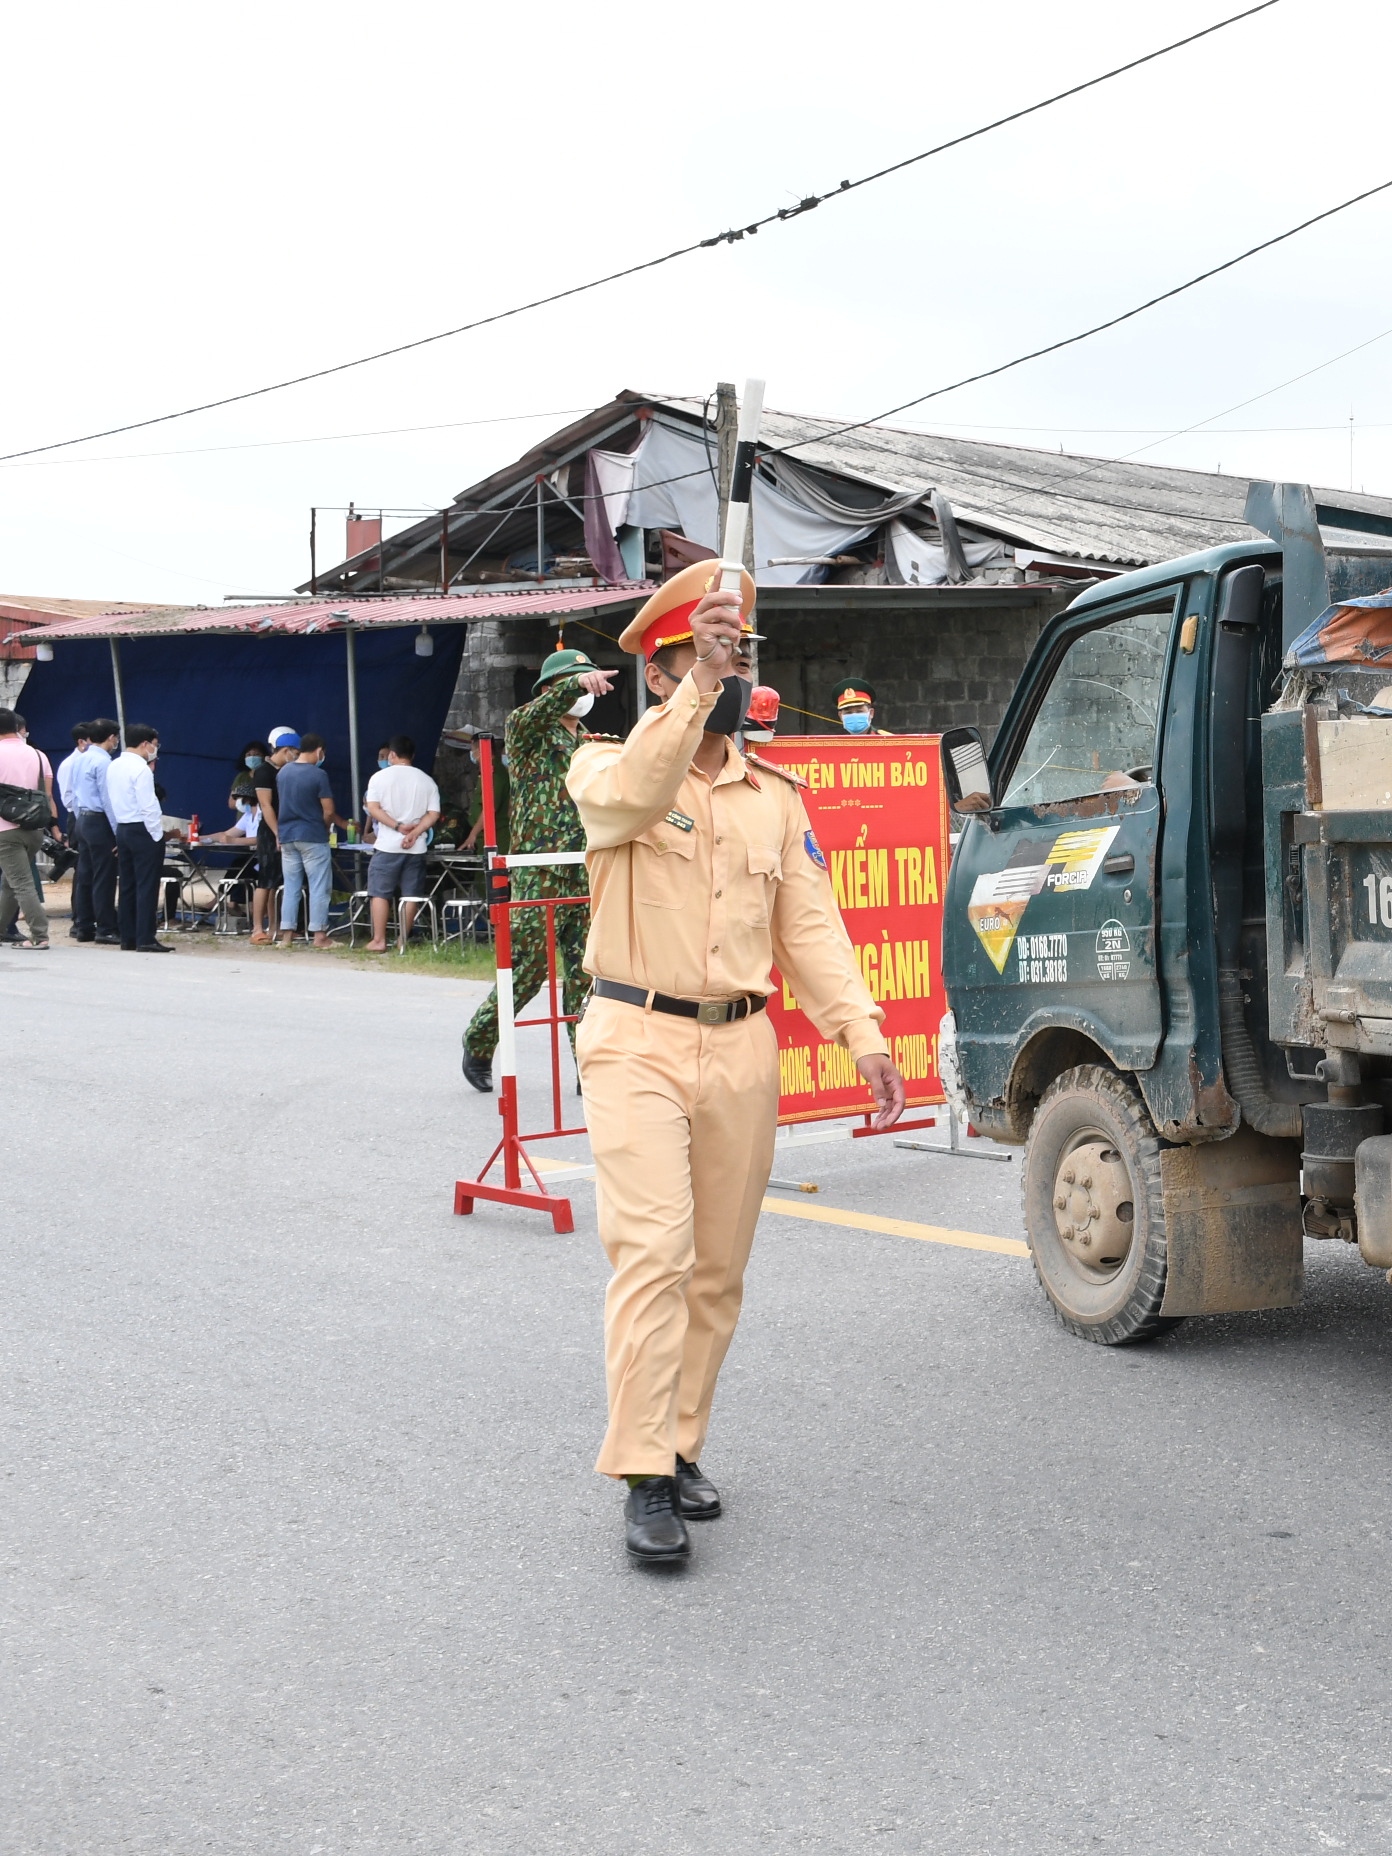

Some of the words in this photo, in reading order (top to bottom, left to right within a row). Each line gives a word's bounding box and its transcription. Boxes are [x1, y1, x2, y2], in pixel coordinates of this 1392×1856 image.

[840, 758, 885, 788] VĨNH
[890, 751, 928, 787] BẢO
[831, 824, 889, 910] KIỂM
[894, 846, 939, 906] TRA
[1047, 870, 1088, 886] FORCIA
[980, 917, 1000, 932] EURO
[1104, 940, 1121, 950] 2N
[895, 1033, 940, 1081] COVID-1
